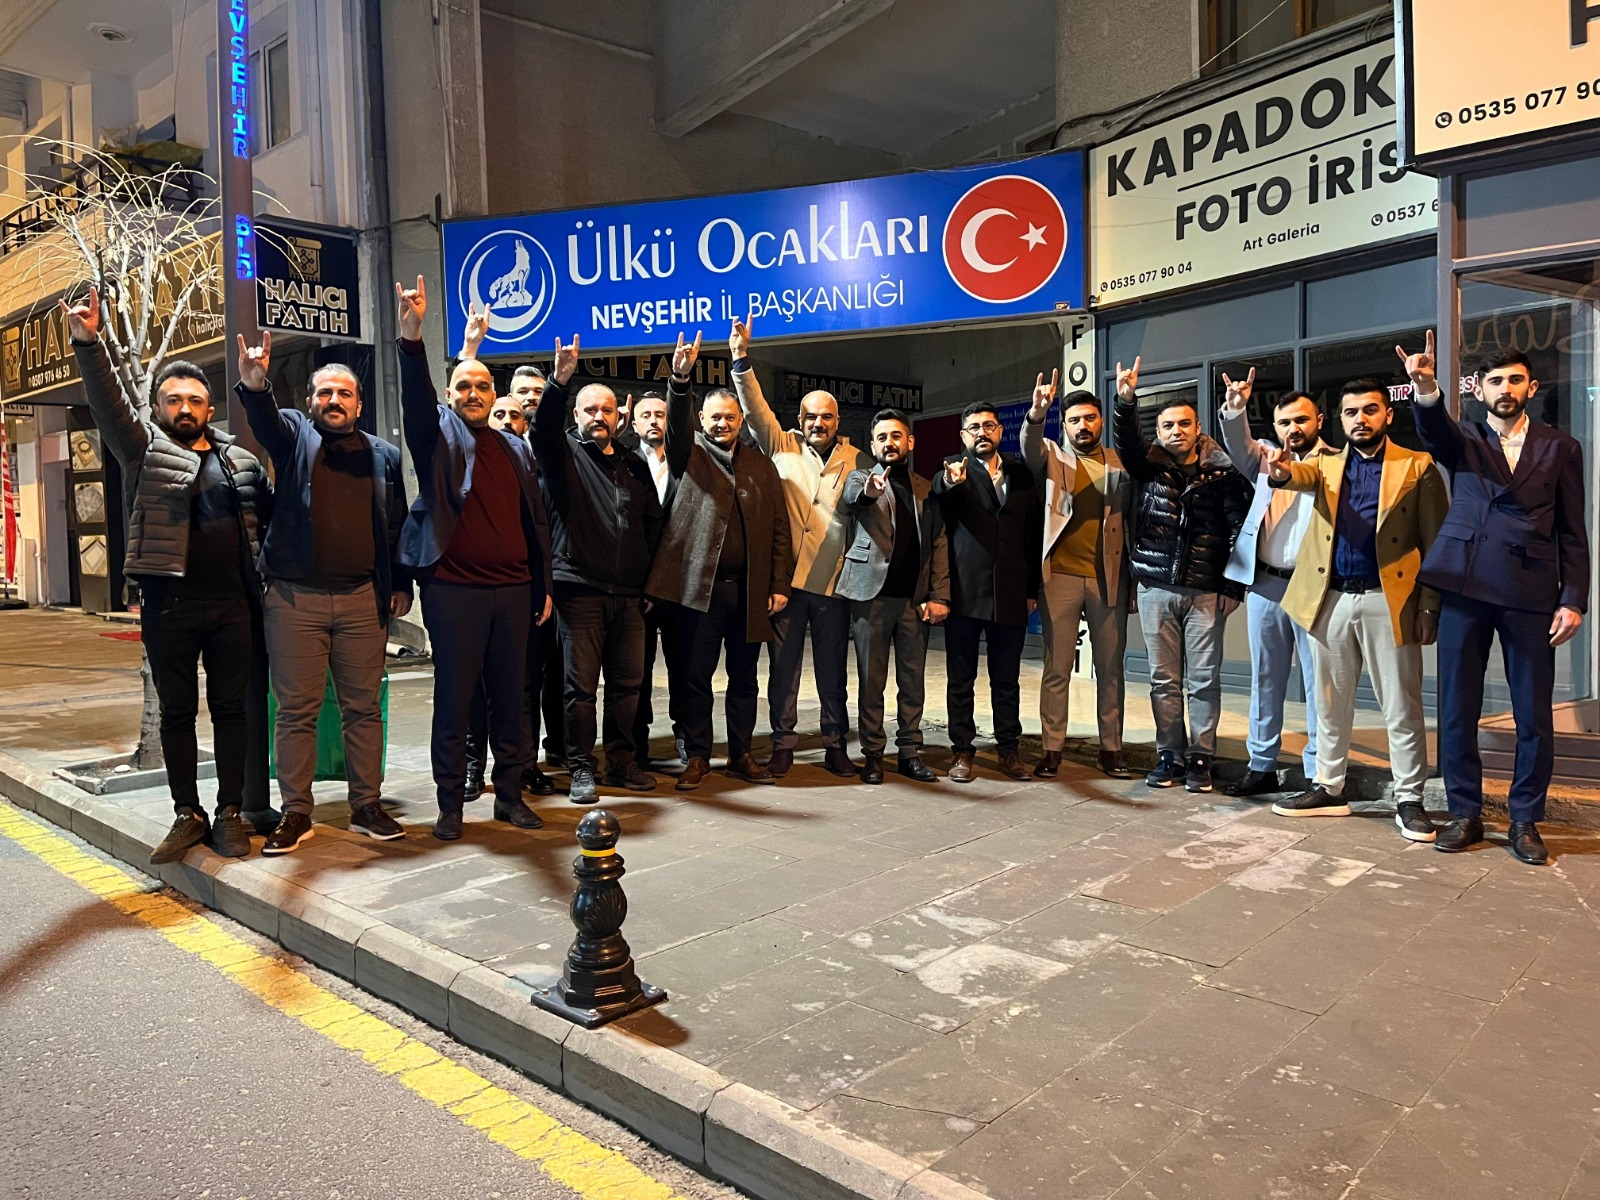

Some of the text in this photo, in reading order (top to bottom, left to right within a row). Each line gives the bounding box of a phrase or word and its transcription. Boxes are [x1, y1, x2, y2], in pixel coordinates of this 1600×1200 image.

[1458, 97, 1516, 124] 0535
[1525, 86, 1567, 110] 077
[1107, 54, 1396, 197] KAPADOK
[1176, 138, 1407, 241] FOTO İRİS
[1386, 202, 1425, 223] 0537
[568, 220, 676, 286] Ülkü
[1243, 222, 1320, 252] Art Galeria
[1110, 261, 1193, 290] 0535 077 90 04
[265, 277, 347, 310] HALICI
[591, 272, 904, 333] NEVŞEHİR İL BAŞKANLIĞI
[32, 364, 70, 387] 0507 976 46 50
